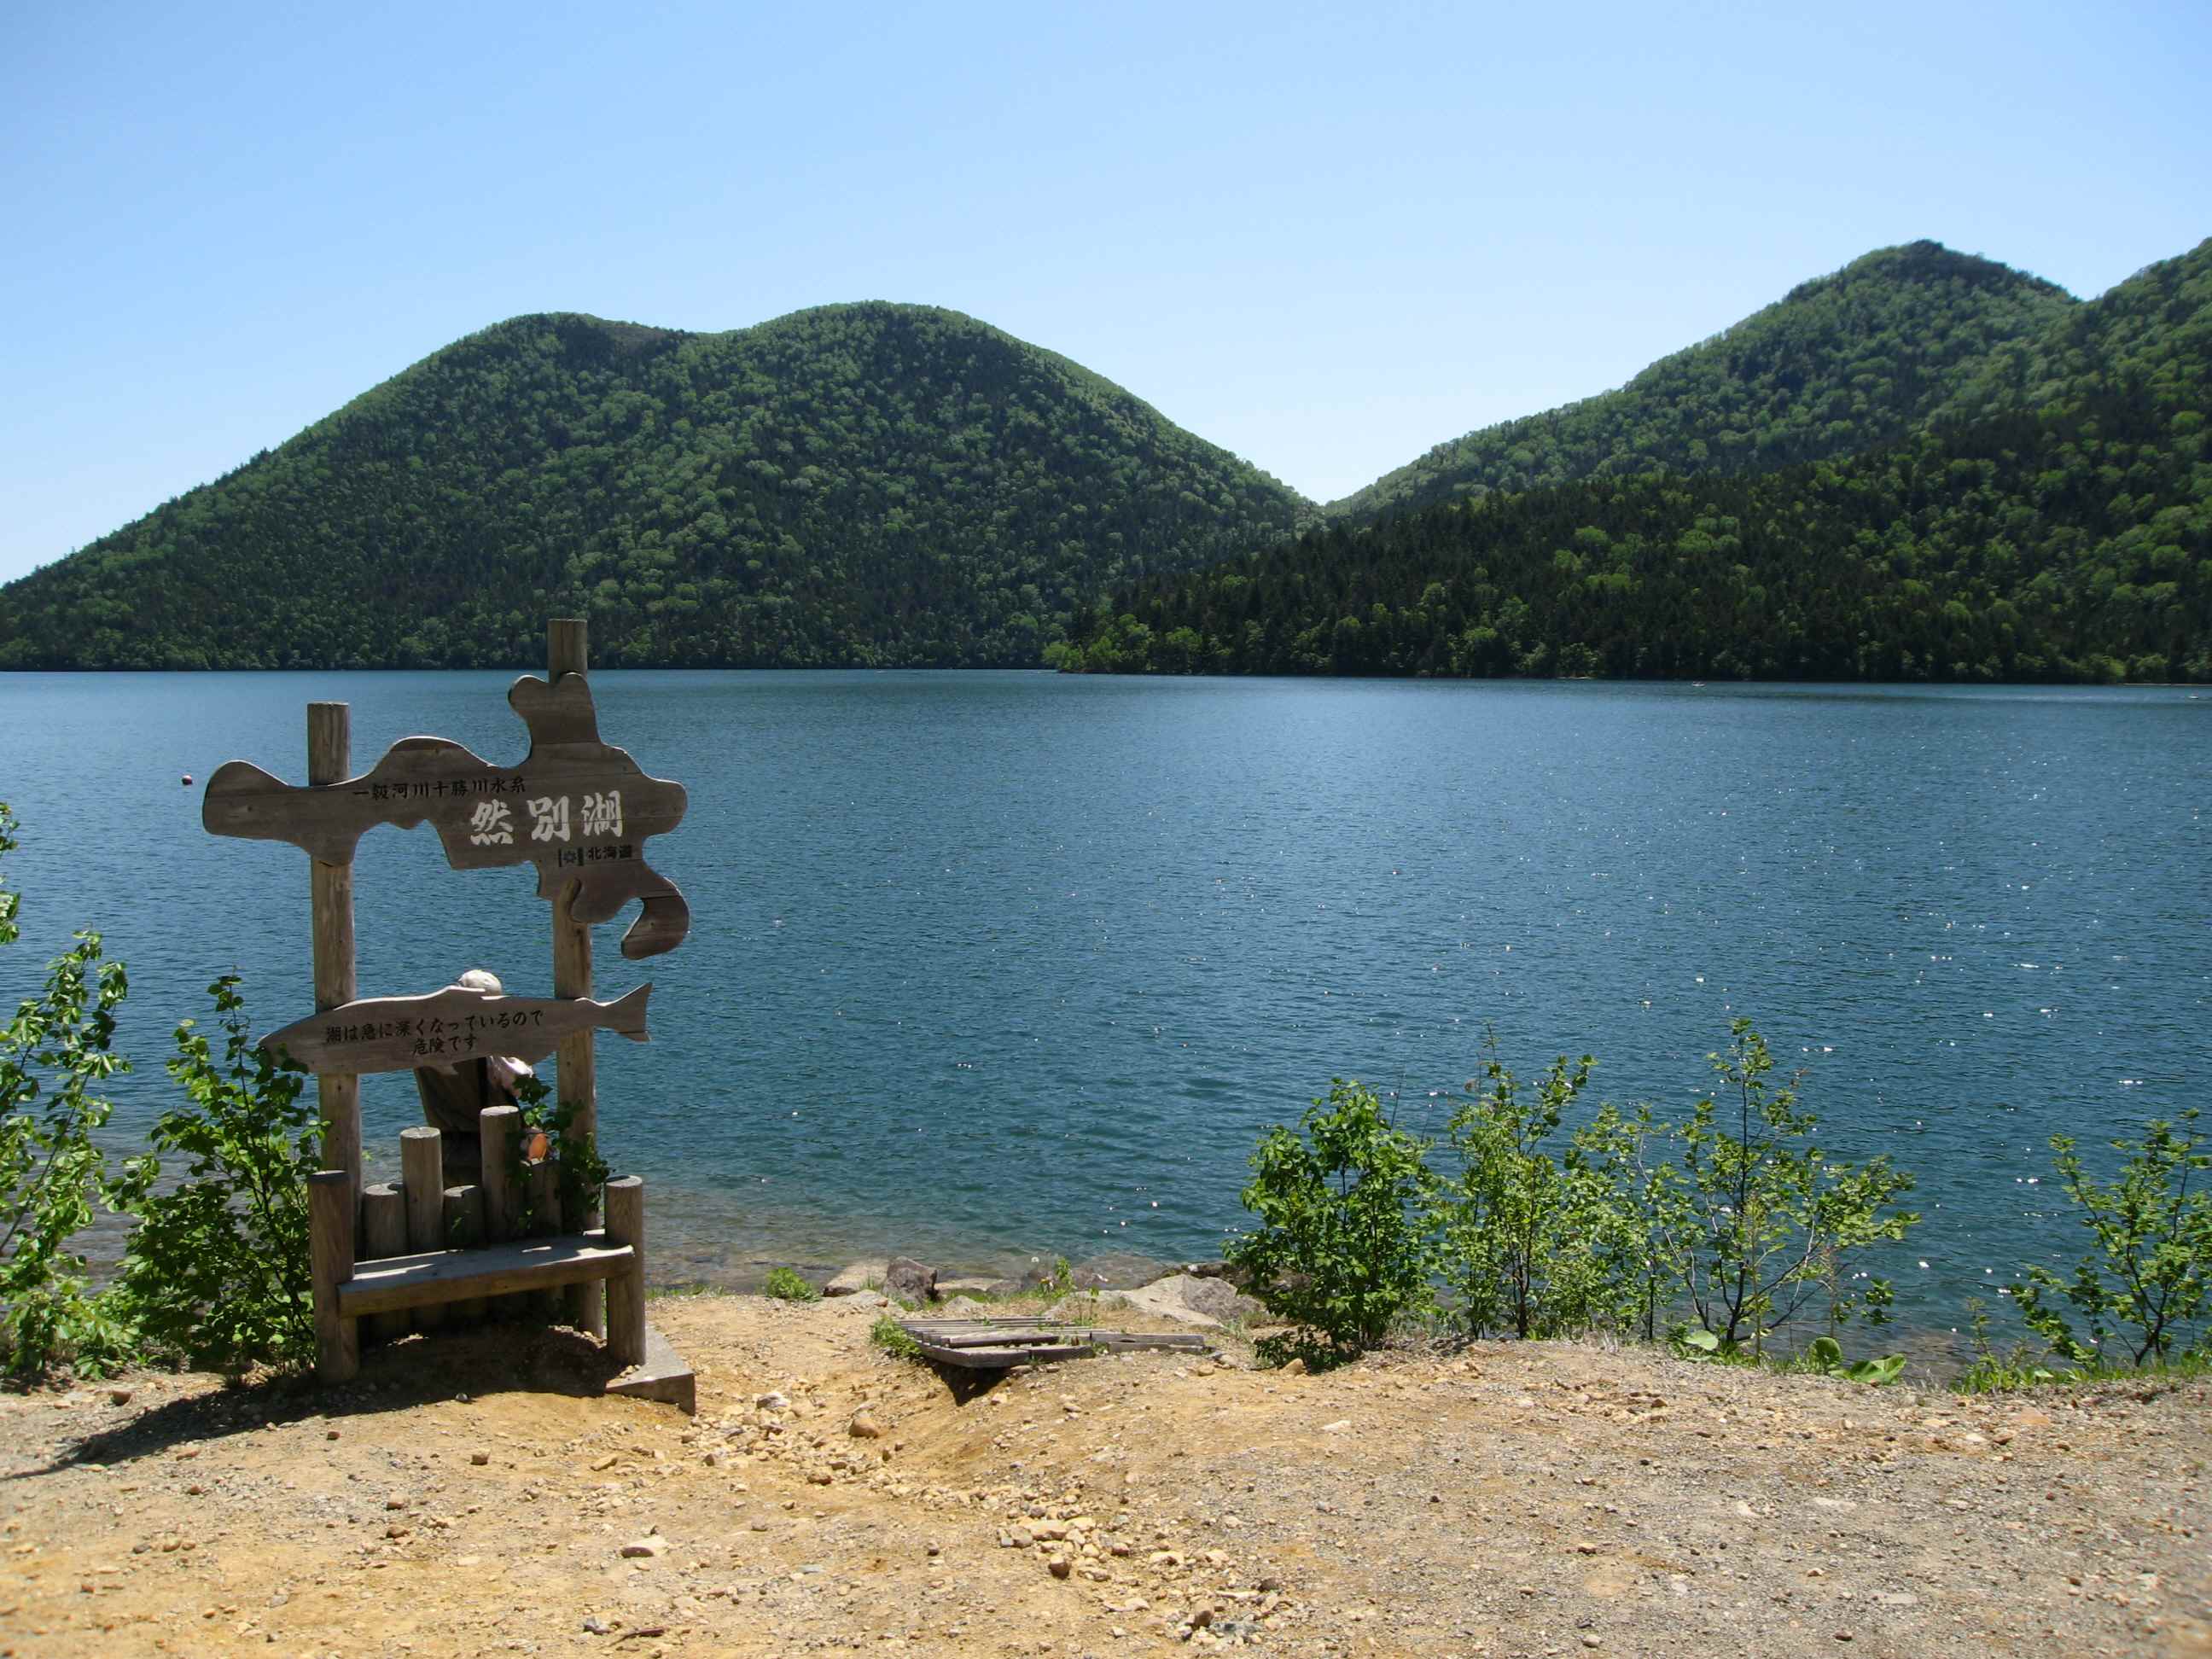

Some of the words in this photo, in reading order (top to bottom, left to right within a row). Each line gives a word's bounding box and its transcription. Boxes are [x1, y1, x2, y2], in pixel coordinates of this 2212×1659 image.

[352, 776, 526, 800] 一級河川十勝川水系
[470, 790, 623, 846] 然別湖
[587, 845, 632, 861] 北海道
[325, 1010, 544, 1045] 湖は急に深くなっているので
[412, 1033, 478, 1056] 危険です
